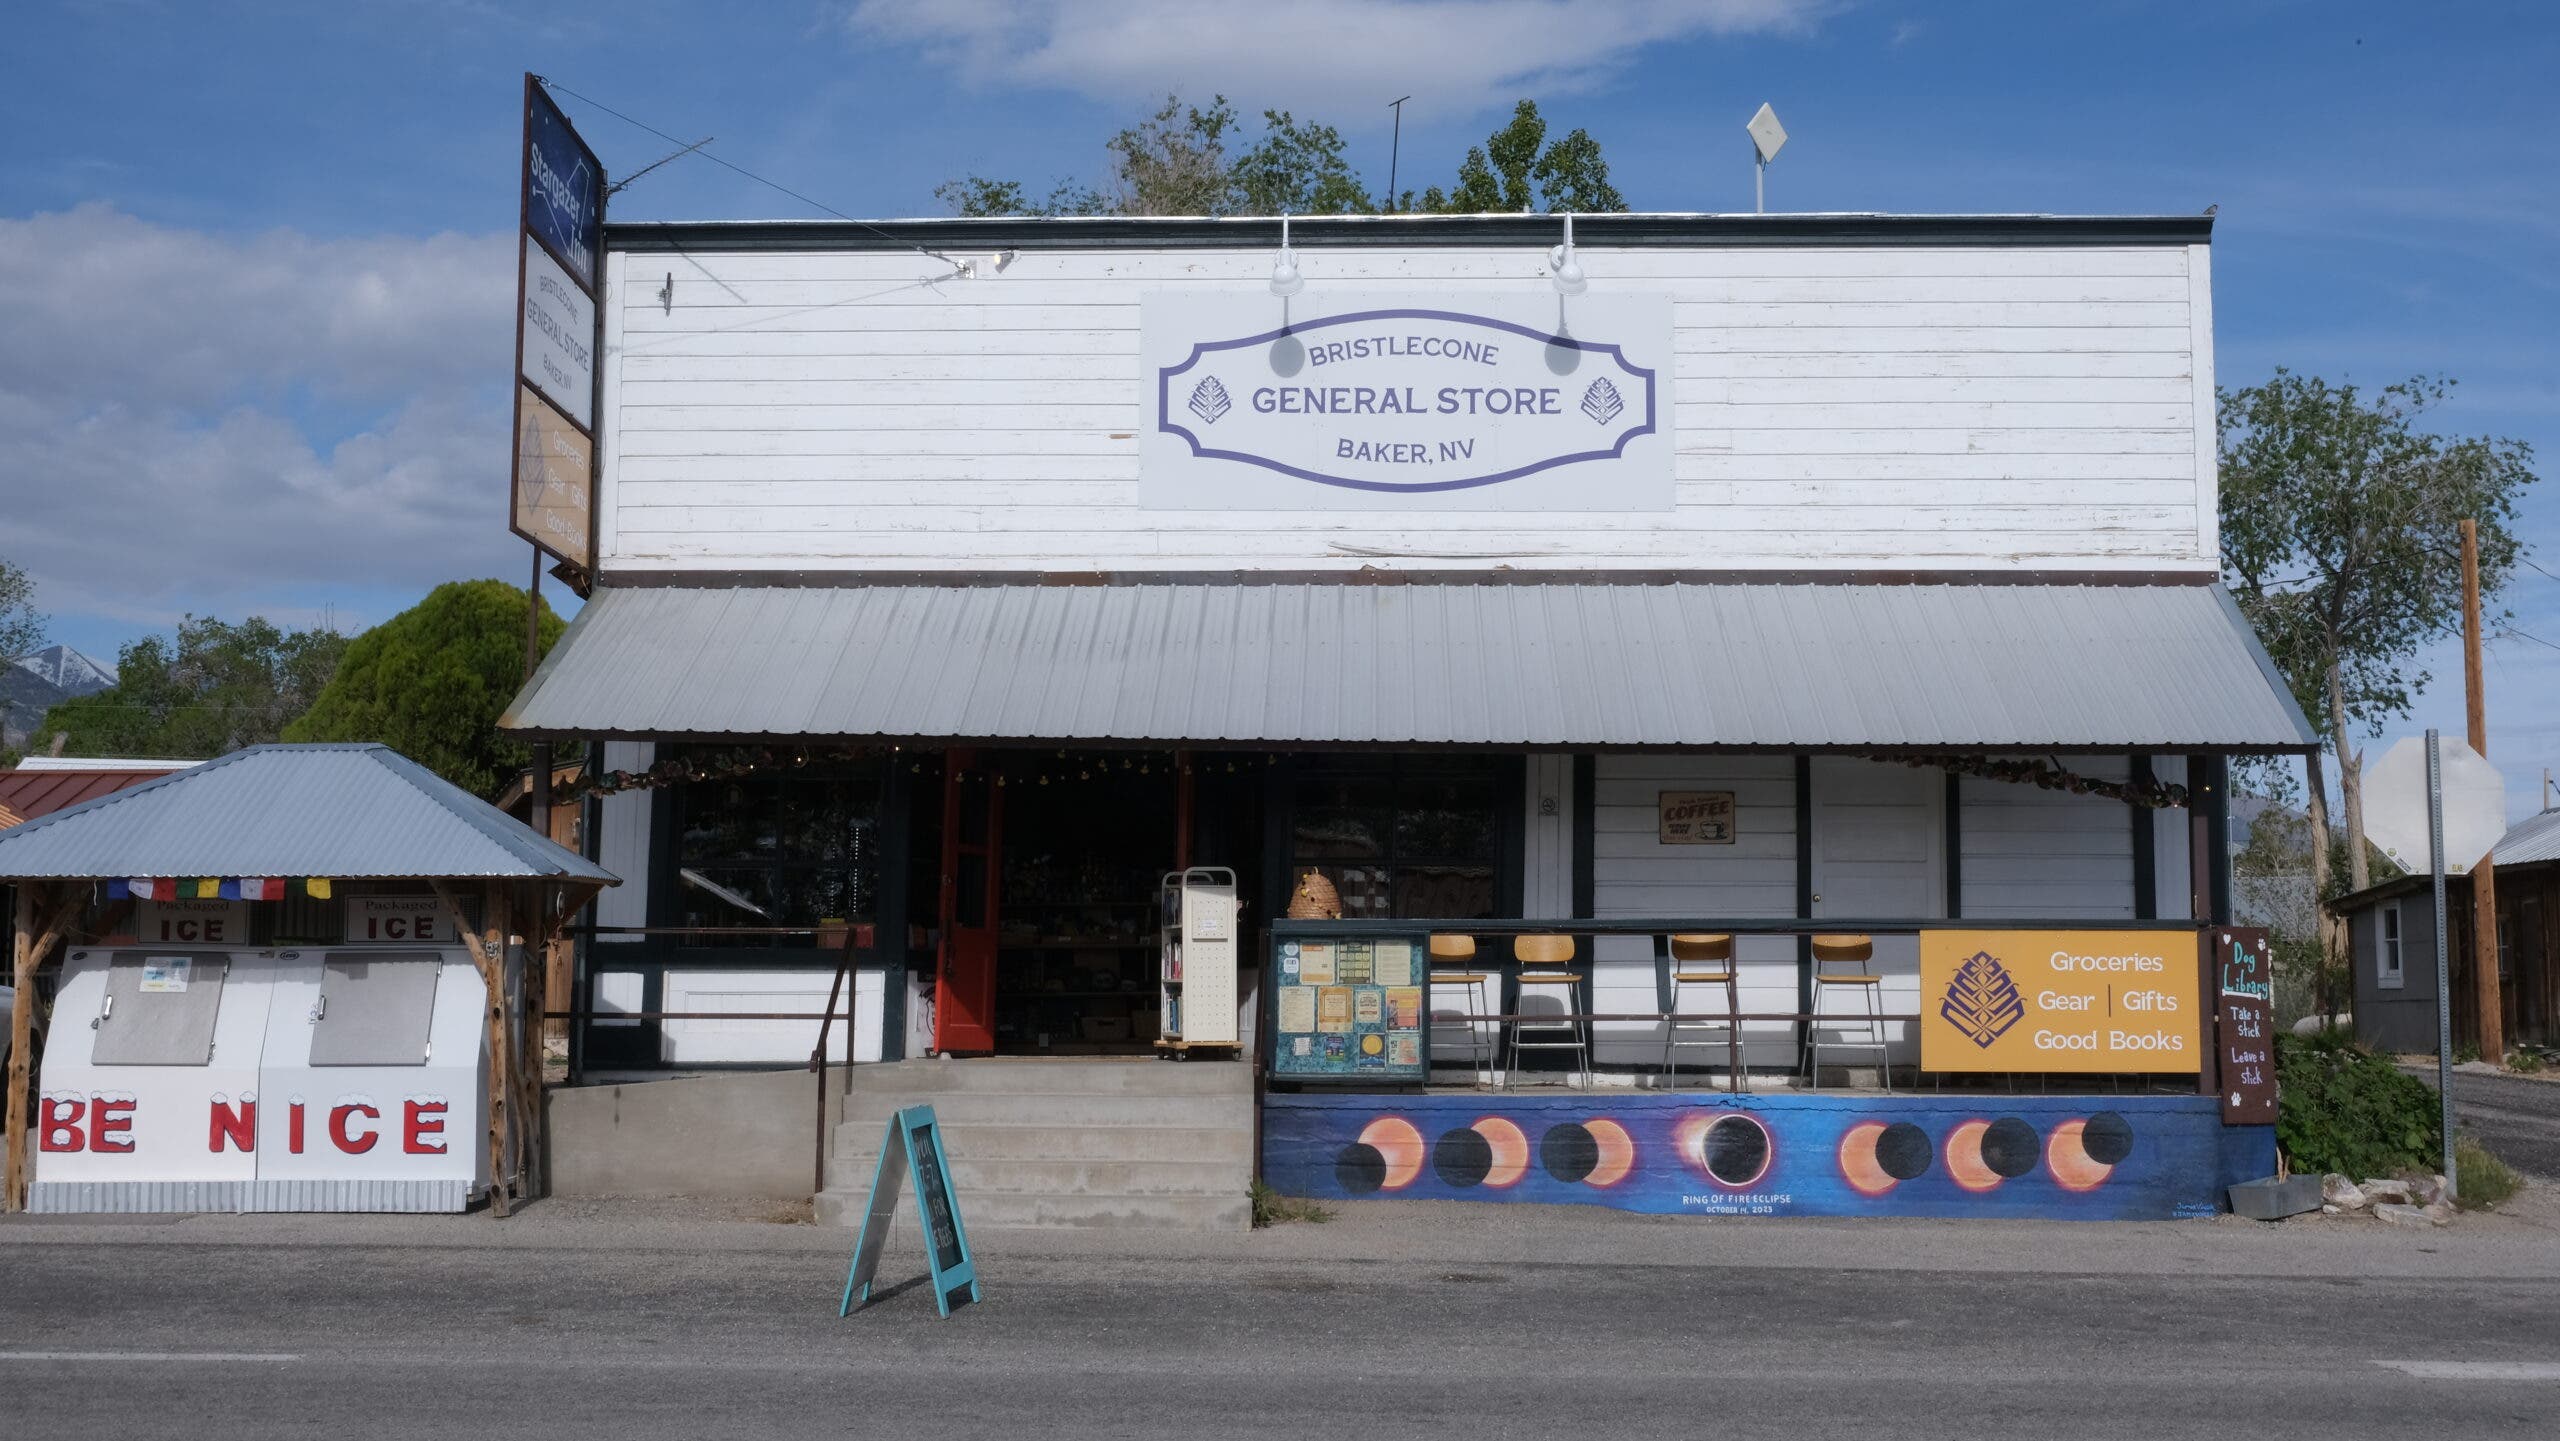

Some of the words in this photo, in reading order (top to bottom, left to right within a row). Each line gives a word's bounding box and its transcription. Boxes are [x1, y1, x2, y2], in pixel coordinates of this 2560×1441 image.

[531, 142, 580, 223] Stargazer
[567, 224, 587, 274] Inn
[540, 275, 578, 325] BRISTLECONE
[526, 297, 563, 348] GENERAL
[564, 332, 589, 372] STORE
[1308, 336, 1499, 367] BRISTLECONE
[564, 374, 577, 391] NV
[1252, 387, 1428, 414] GENERAL
[1436, 387, 1562, 415] STORE
[1336, 438, 1433, 465] BAKER,
[1438, 438, 1476, 462] NV
[546, 508, 566, 537] Good
[1663, 800, 1730, 821] COFFEE
[157, 900, 230, 912] Packaged
[365, 900, 438, 911] Packaged
[160, 919, 224, 941] ICE
[367, 916, 434, 939] ICE
[2050, 951, 2164, 972] Groceries
[2233, 941, 2256, 973] Dog
[2223, 963, 2269, 999] Library
[2038, 990, 2095, 1011] Gear
[2123, 990, 2178, 1011] Gifts
[2230, 1006, 2252, 1020] Take
[2254, 1009, 2260, 1020] a
[2034, 1029, 2098, 1050] Good
[2109, 1030, 2183, 1050] Books
[2238, 1021, 2261, 1038] stick
[2231, 1047, 2257, 1063] Leave
[2259, 1050, 2265, 1062] a
[2241, 1066, 2263, 1085] stick
[40, 1090, 137, 1153] BE
[208, 1091, 449, 1154] NICE
[1682, 1195, 1708, 1205] RING
[1711, 1194, 1724, 1204] OF
[1728, 1194, 1750, 1203] FIRE
[1753, 1194, 1791, 1204] ECLIPSE
[1706, 1206, 1738, 1214] OCTOBER
[1752, 1205, 1773, 1214] 2023
